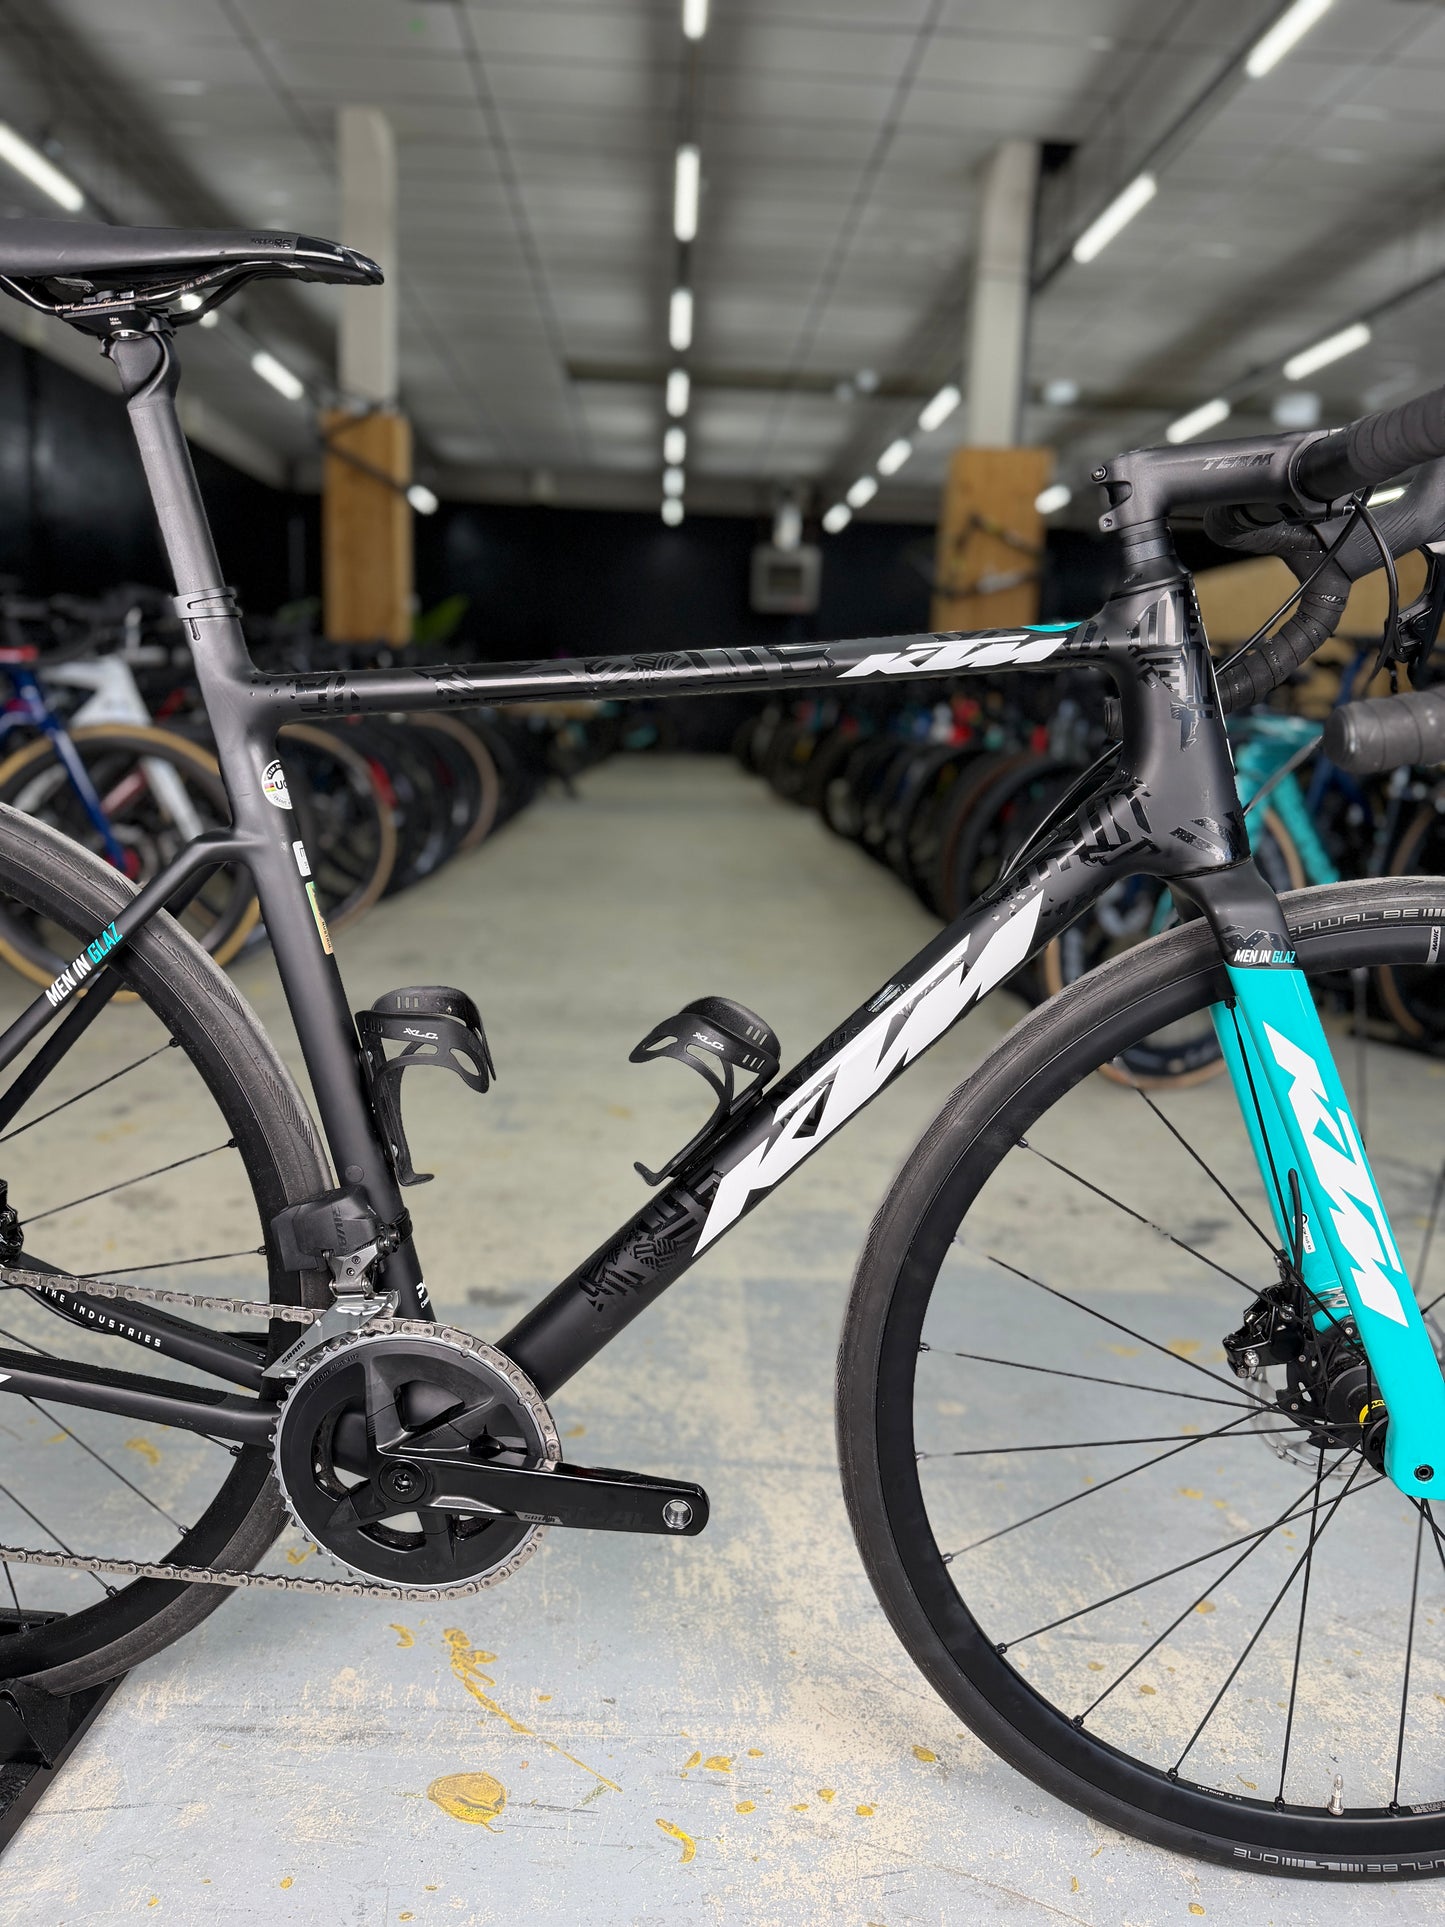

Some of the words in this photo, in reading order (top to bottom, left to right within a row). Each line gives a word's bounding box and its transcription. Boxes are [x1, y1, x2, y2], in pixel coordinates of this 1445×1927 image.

[1203, 452, 1276, 471] TEAM
[836, 634, 1068, 679] KTM
[45, 968, 77, 1007] MEN
[72, 953, 92, 980] IN
[86, 921, 123, 964] GLAZ
[1233, 949, 1259, 963] MEN
[1259, 949, 1272, 963] IN
[1271, 950, 1296, 964] GLAZ
[691, 889, 1044, 1258] KTM
[1262, 1020, 1409, 1328] KTM
[73, 1302, 162, 1347] INDUSTRIES
[282, 1340, 305, 1364] SRAM
[1233, 1847, 1279, 1866] ONE
